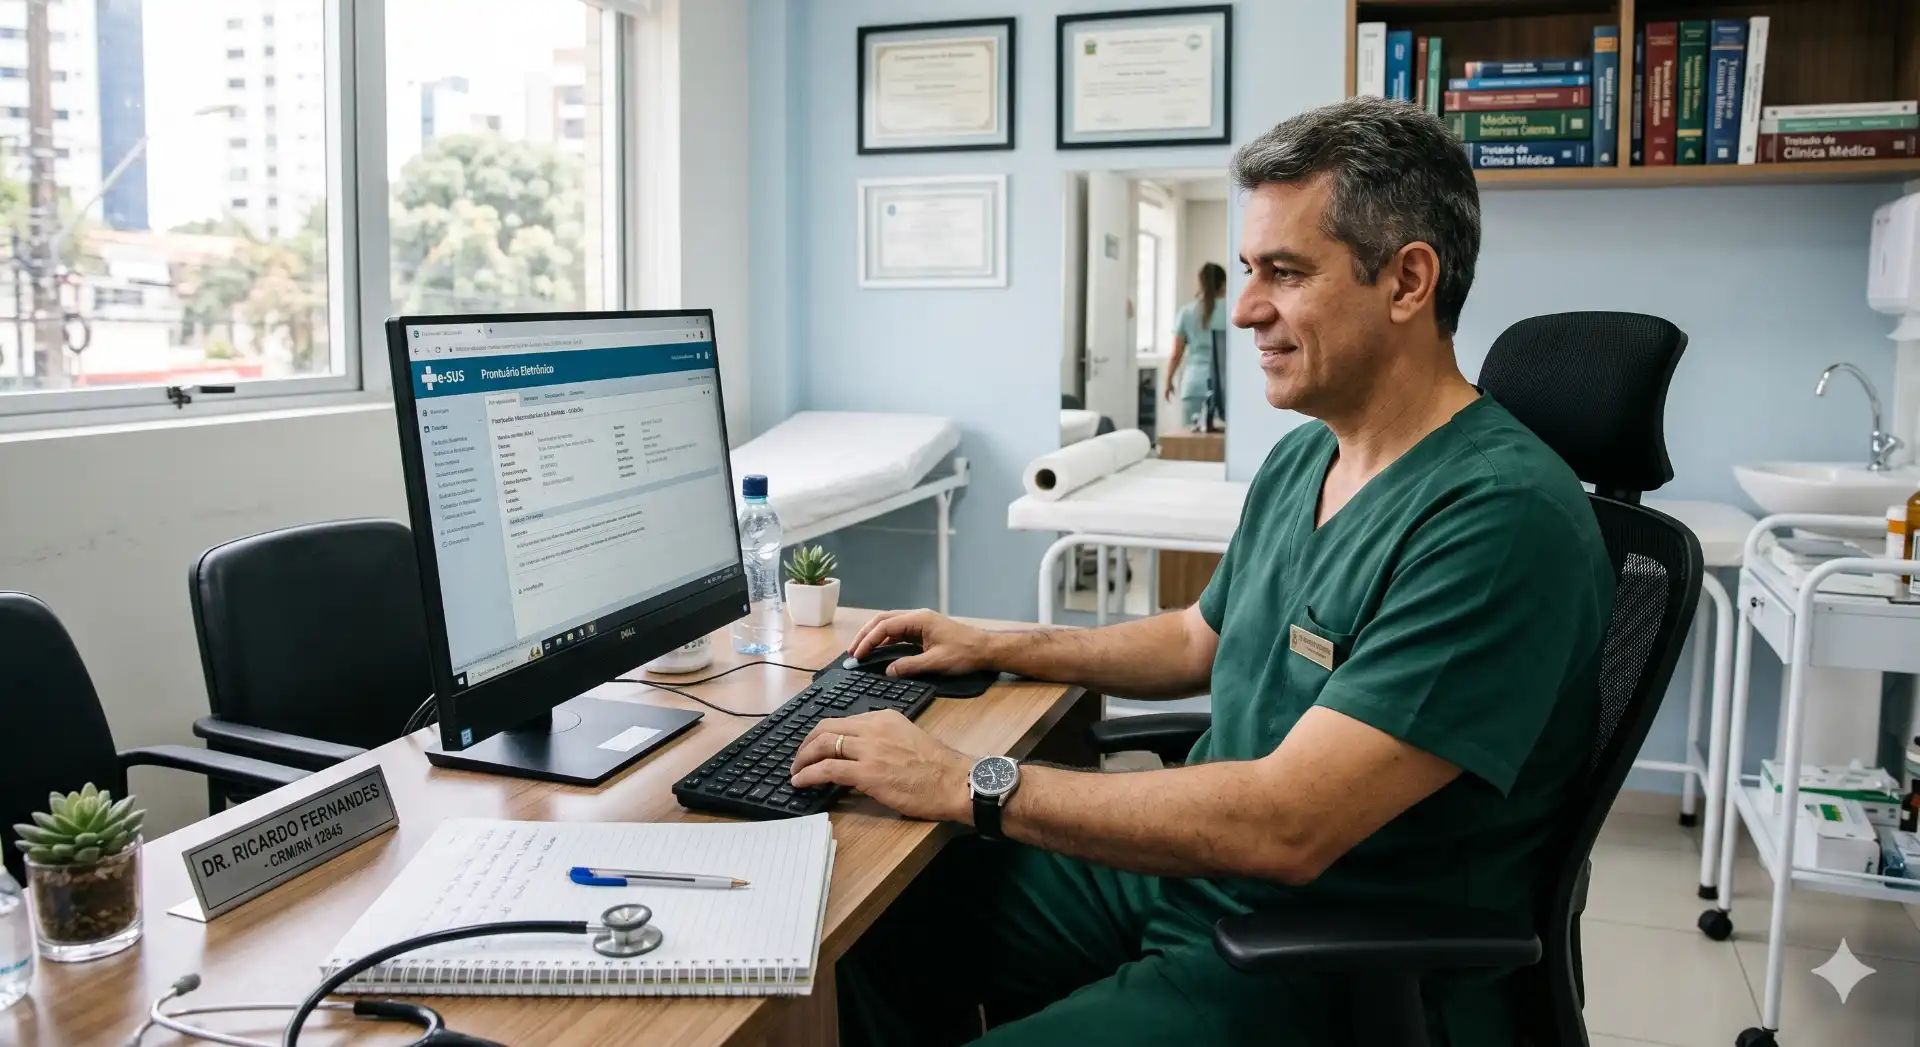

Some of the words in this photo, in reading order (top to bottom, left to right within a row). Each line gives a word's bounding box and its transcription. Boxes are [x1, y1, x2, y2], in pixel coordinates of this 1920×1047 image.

[437, 369, 465, 384] e-SUS
[481, 366, 520, 380] Prontuário
[520, 363, 555, 377] Eletrônico
[620, 627, 636, 640] DELL
[201, 853, 232, 878] DR.
[232, 819, 299, 865] RICARDO
[300, 782, 381, 832] FERNANDES
[269, 838, 314, 869] CRM/RN
[313, 822, 344, 846] 12845
